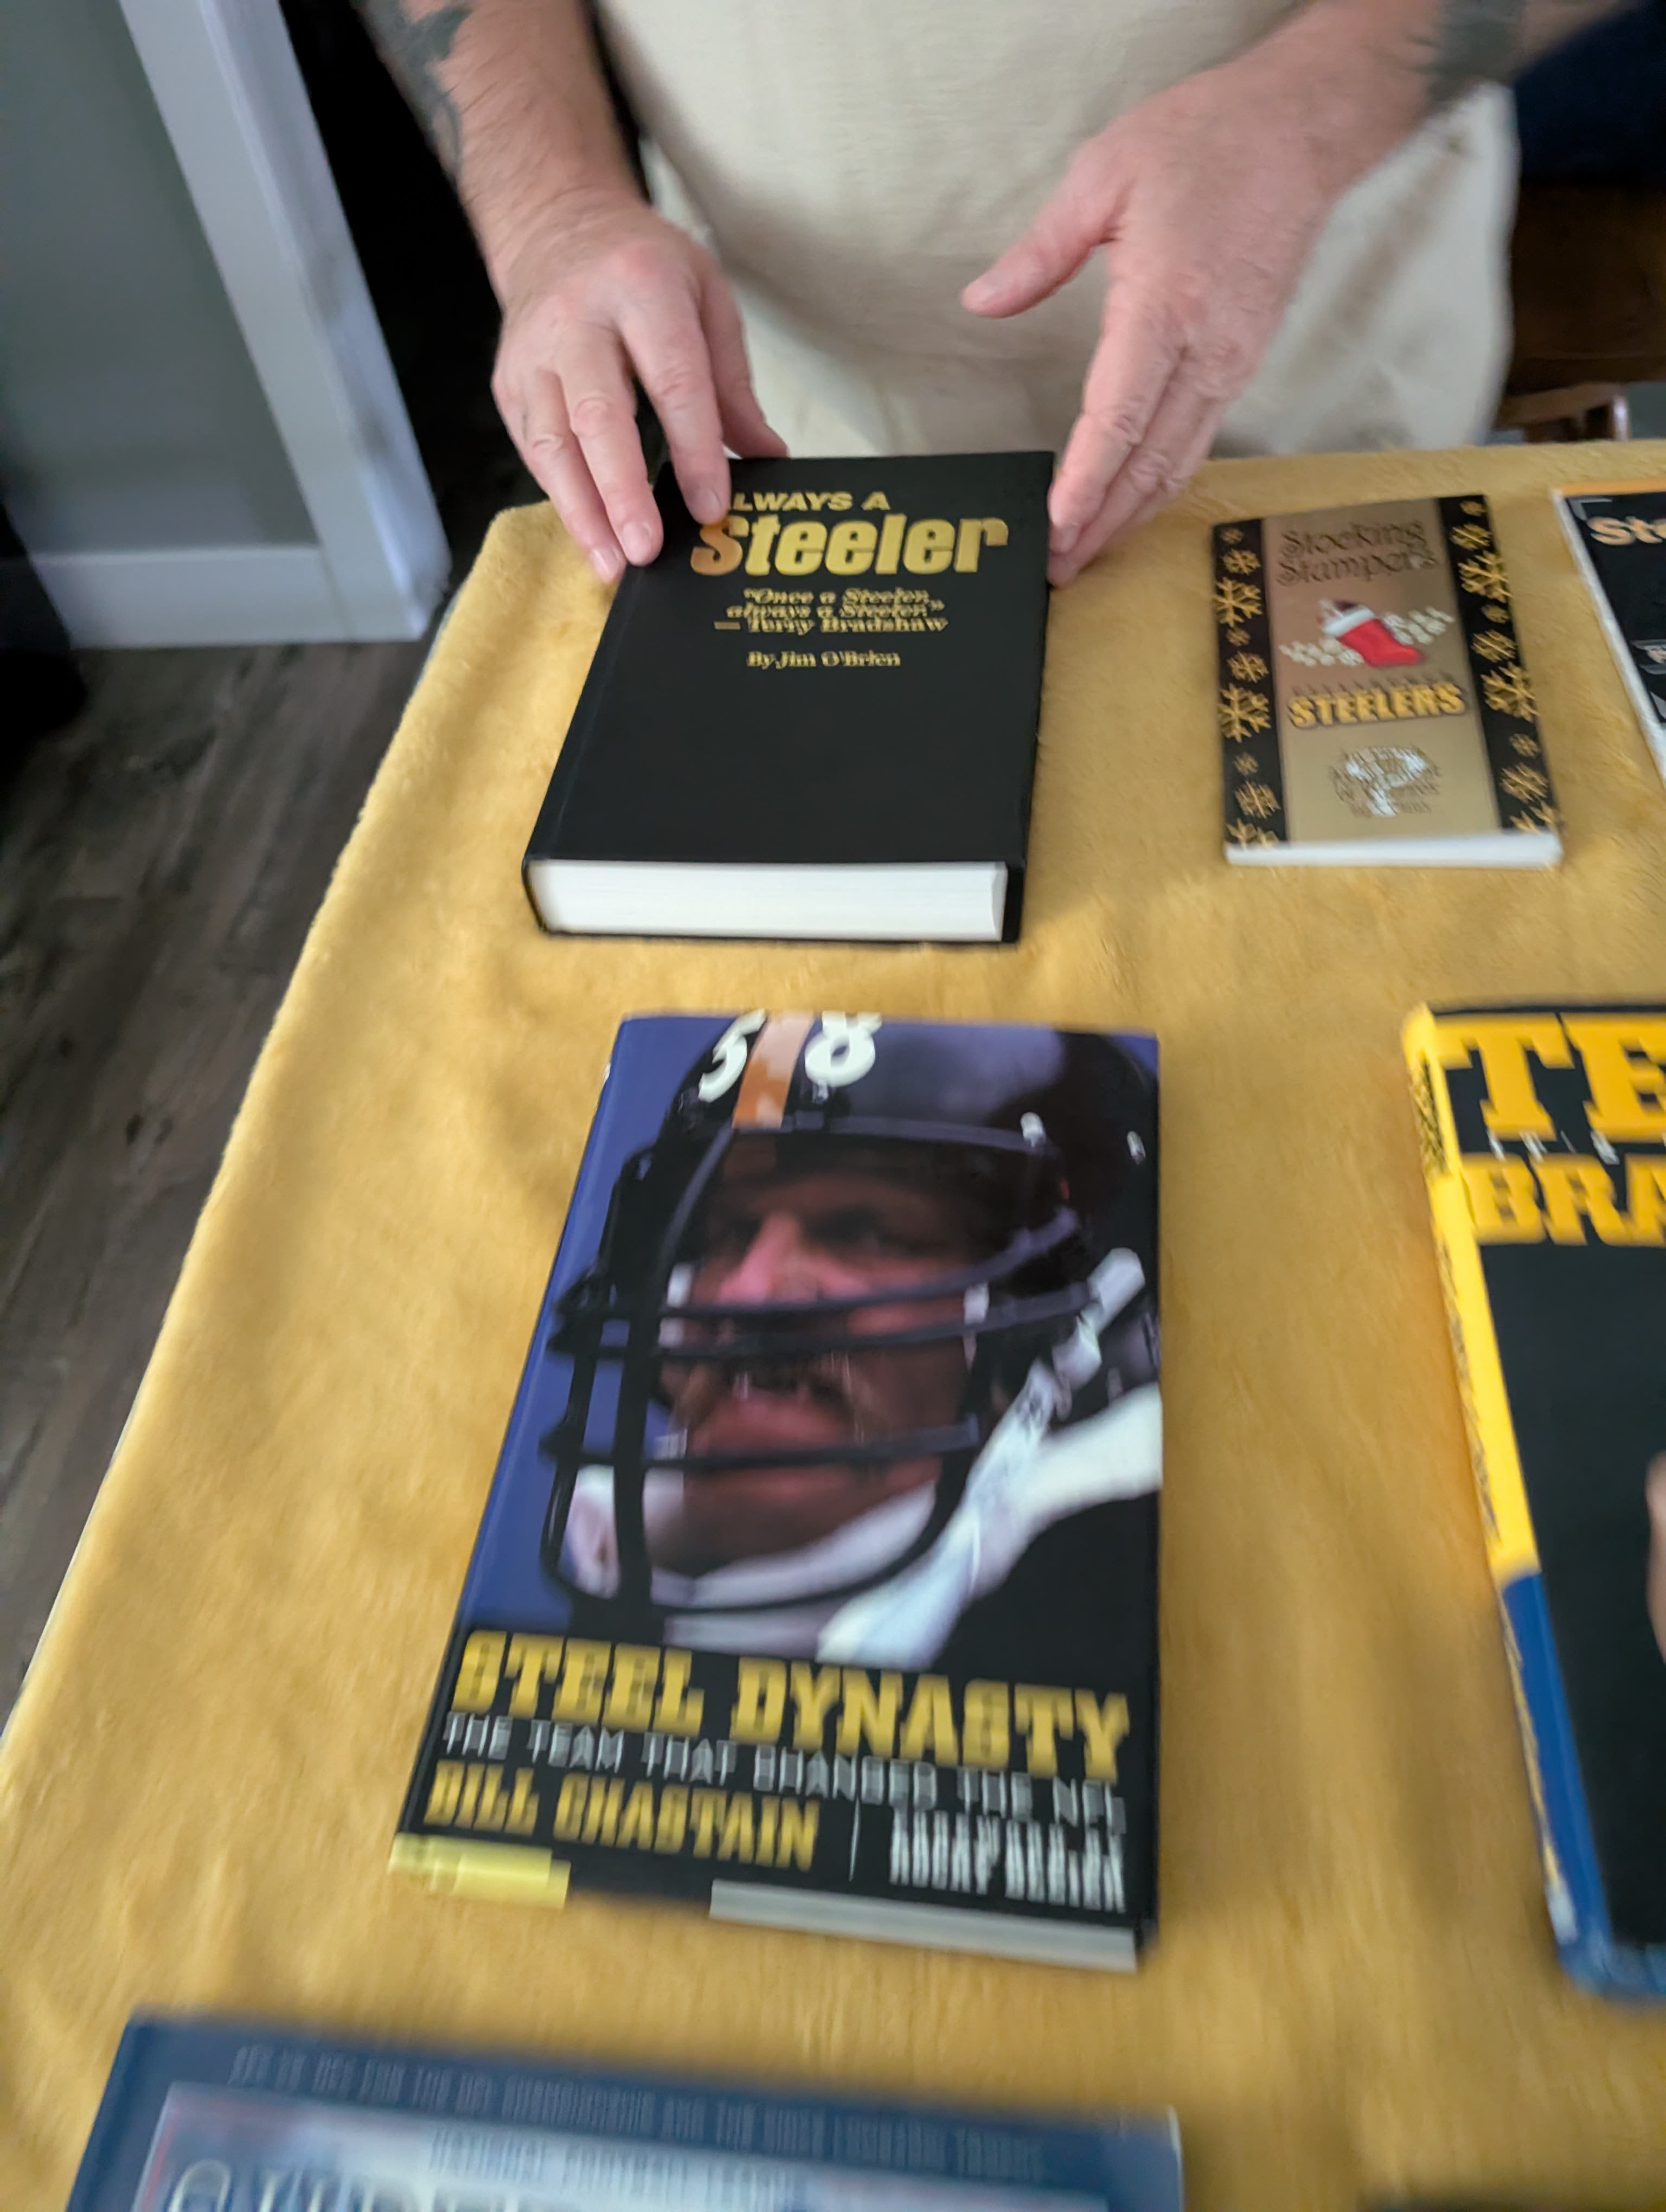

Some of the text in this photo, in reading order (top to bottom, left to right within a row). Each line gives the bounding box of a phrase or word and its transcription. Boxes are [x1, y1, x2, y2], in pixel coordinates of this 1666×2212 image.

[731, 491, 891, 512] LWAYS A
[690, 513, 1010, 577] Steeler
[1280, 521, 1428, 558] Stocking
[726, 602, 811, 621] always
[816, 605, 834, 619] a
[819, 591, 836, 604] a
[820, 616, 949, 632] Bradshaw
[746, 650, 901, 670] By Jim O'Brien
[1287, 680, 1465, 729] STEELERS
[452, 1629, 1131, 1785] STEEL DYNASTY
[443, 1712, 513, 1760] THE
[527, 1719, 625, 1773] TEAM
[641, 1732, 738, 1786] THAT
[424, 1759, 540, 1837] BILL
[553, 1772, 820, 1872] CHASTAIN
